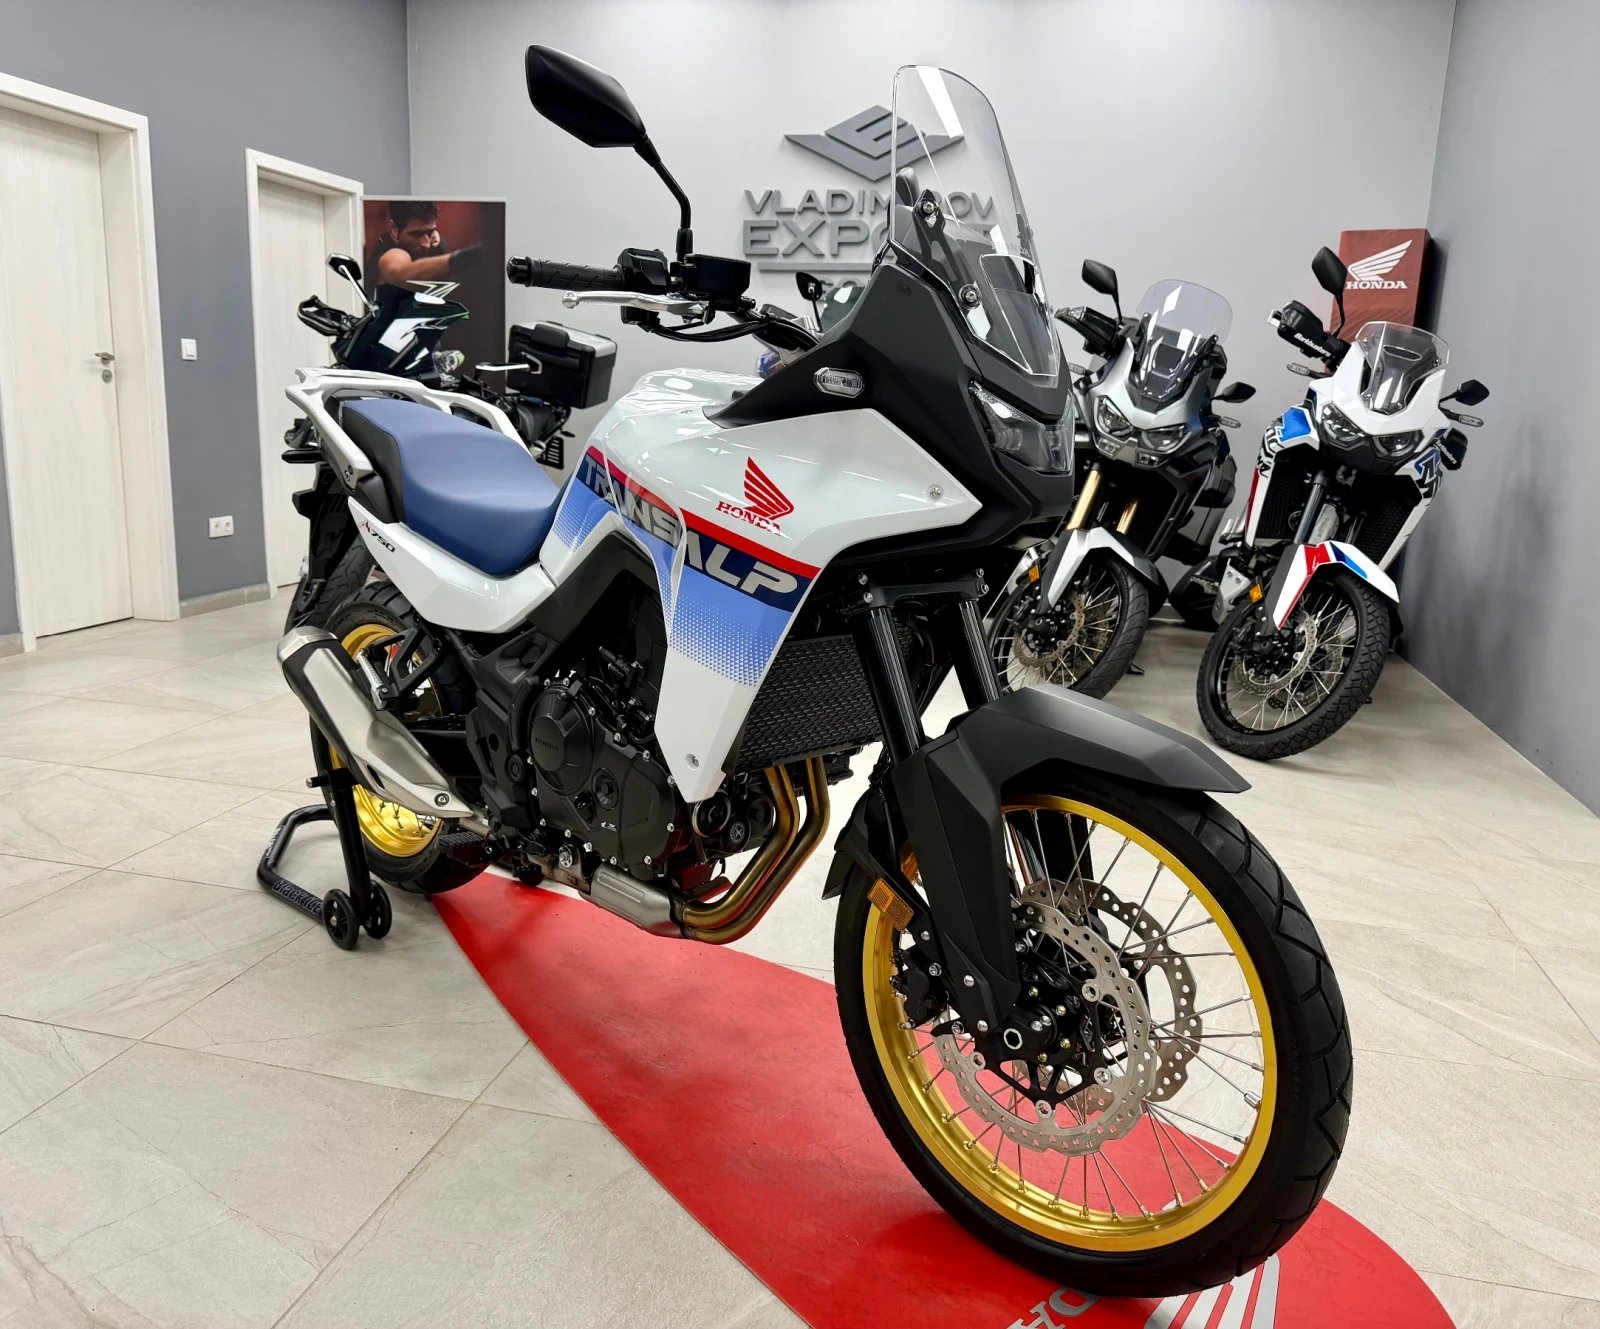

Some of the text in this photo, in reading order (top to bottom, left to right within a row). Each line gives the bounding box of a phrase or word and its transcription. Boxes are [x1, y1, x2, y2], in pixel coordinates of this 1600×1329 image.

[744, 189, 993, 218] VLADIMOV
[1345, 280, 1408, 290] HONDA
[1293, 332, 1332, 358] Barkbusters
[584, 454, 798, 595] TRANSALP
[715, 500, 782, 537] HONDA
[370, 528, 396, 553] 750
